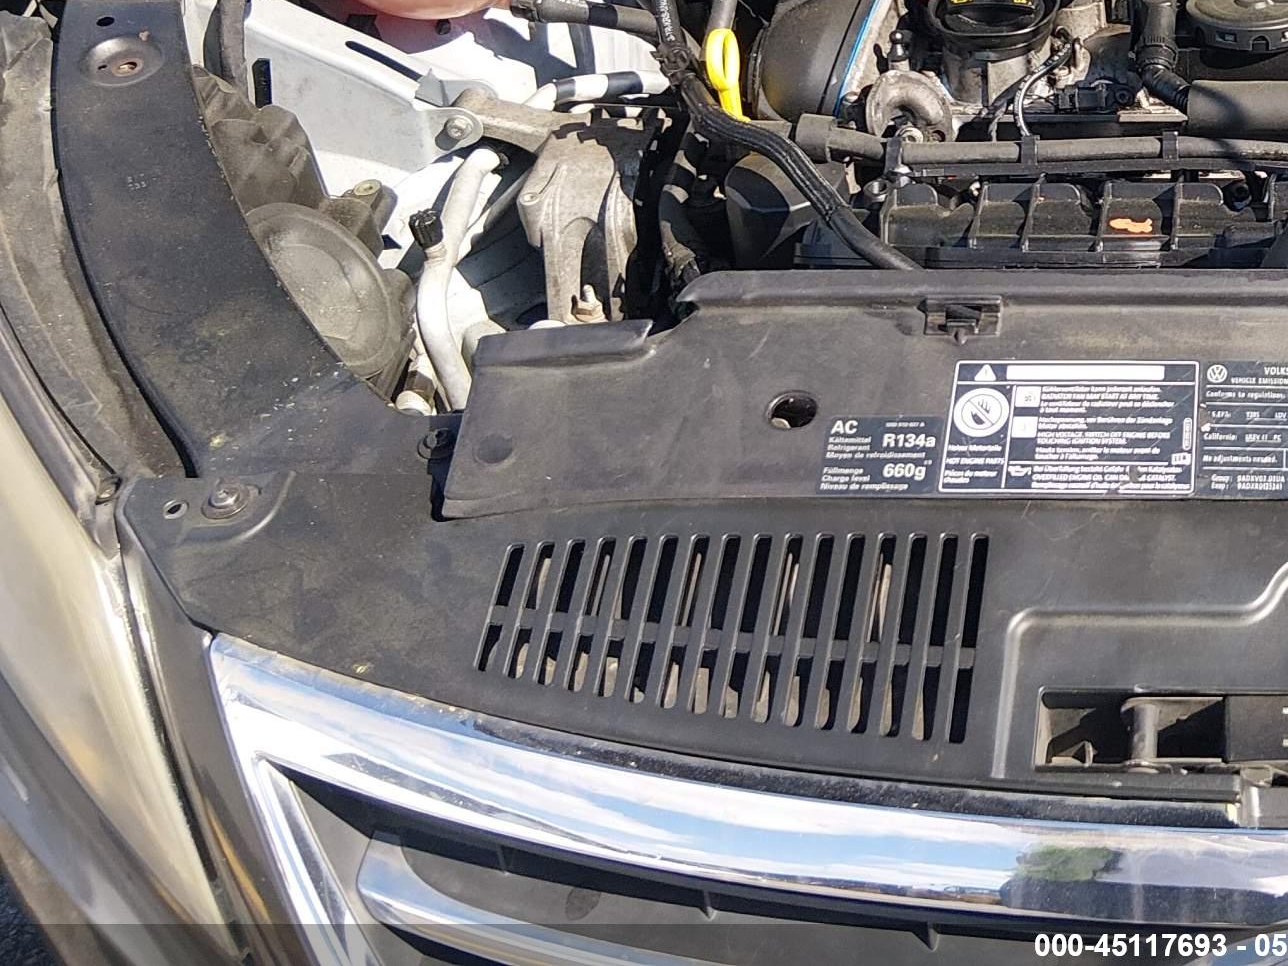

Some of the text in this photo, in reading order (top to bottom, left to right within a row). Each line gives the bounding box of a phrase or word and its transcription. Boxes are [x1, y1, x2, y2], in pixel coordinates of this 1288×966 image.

[1231, 376, 1256, 385] VEHICLE
[1258, 377, 1288, 385] EMISSION
[1206, 390, 1235, 398] Conforms
[1238, 390, 1246, 398] to
[831, 420, 859, 435] AC
[829, 436, 873, 444] Kältemittel
[882, 433, 936, 448] R134a
[1203, 433, 1238, 441] California:
[828, 444, 871, 453] Refrigerant
[826, 452, 853, 460] Moyen
[823, 467, 864, 476] Füllmenge
[883, 464, 927, 482] 660g
[822, 475, 850, 483] Charge
[820, 482, 848, 490] Niveau
[861, 483, 909, 491] remplissage
